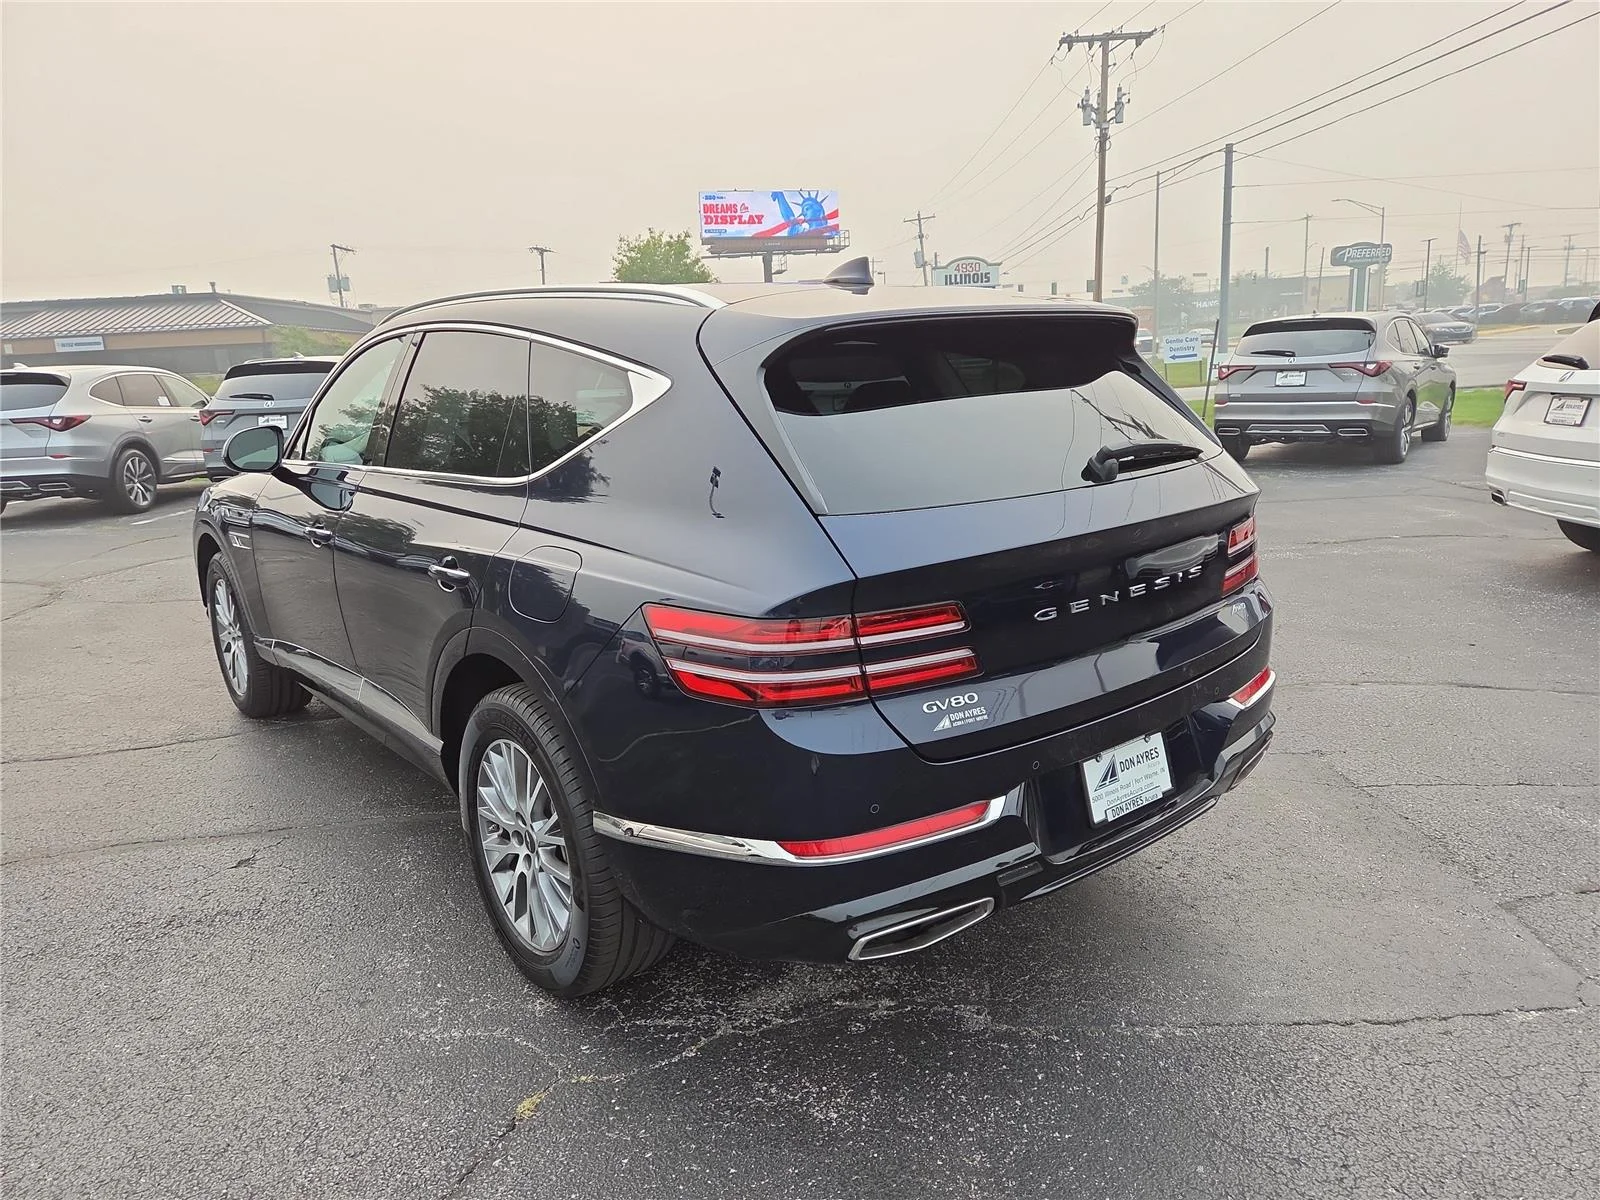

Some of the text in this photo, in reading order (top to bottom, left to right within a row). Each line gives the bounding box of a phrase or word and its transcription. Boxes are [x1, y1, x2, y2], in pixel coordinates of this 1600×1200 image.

[703, 204, 738, 214] DREAMS
[704, 215, 764, 225] DISPLAY
[1343, 247, 1392, 262] PREFERRED
[955, 262, 981, 273] 4930
[944, 272, 991, 286] ILLINOIS
[1169, 345, 1196, 353] Dentistry
[1034, 565, 1202, 621] GENESIS
[922, 692, 979, 713] GV80
[950, 707, 987, 721] DON AYRES
[1119, 747, 1160, 773] DON AYRES
[1120, 782, 1131, 791] Road
[1134, 776, 1144, 784] Fort
[1111, 793, 1158, 818] DON AYRES Acura
